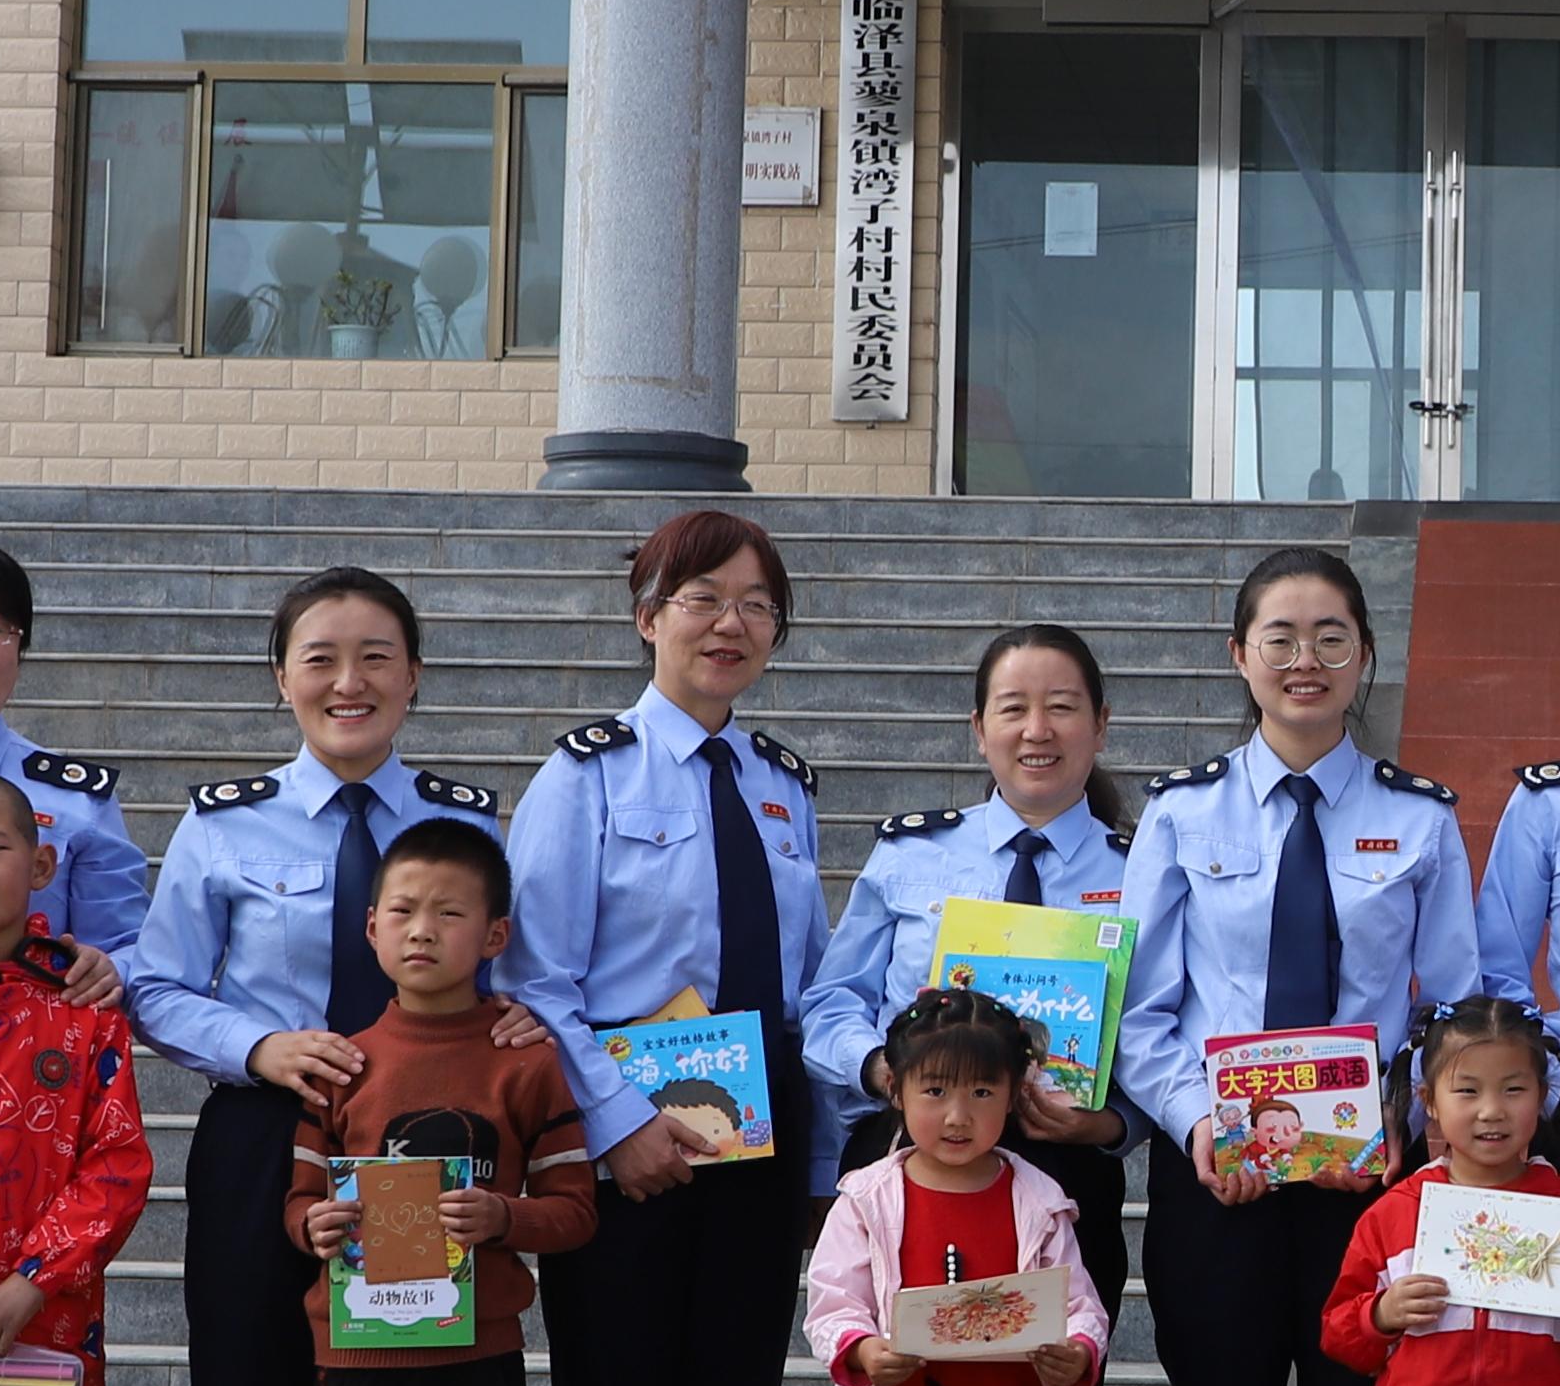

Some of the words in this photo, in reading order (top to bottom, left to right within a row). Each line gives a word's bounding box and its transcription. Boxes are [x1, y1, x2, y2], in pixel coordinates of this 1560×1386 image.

[1002, 972, 1058, 987] 身体小问号
[643, 1028, 730, 1051] 宝宝好性格故事
[1220, 1059, 1366, 1098] 大字大图成语
[474, 1159, 493, 1179] 10
[369, 1289, 435, 1306] 动物故事
